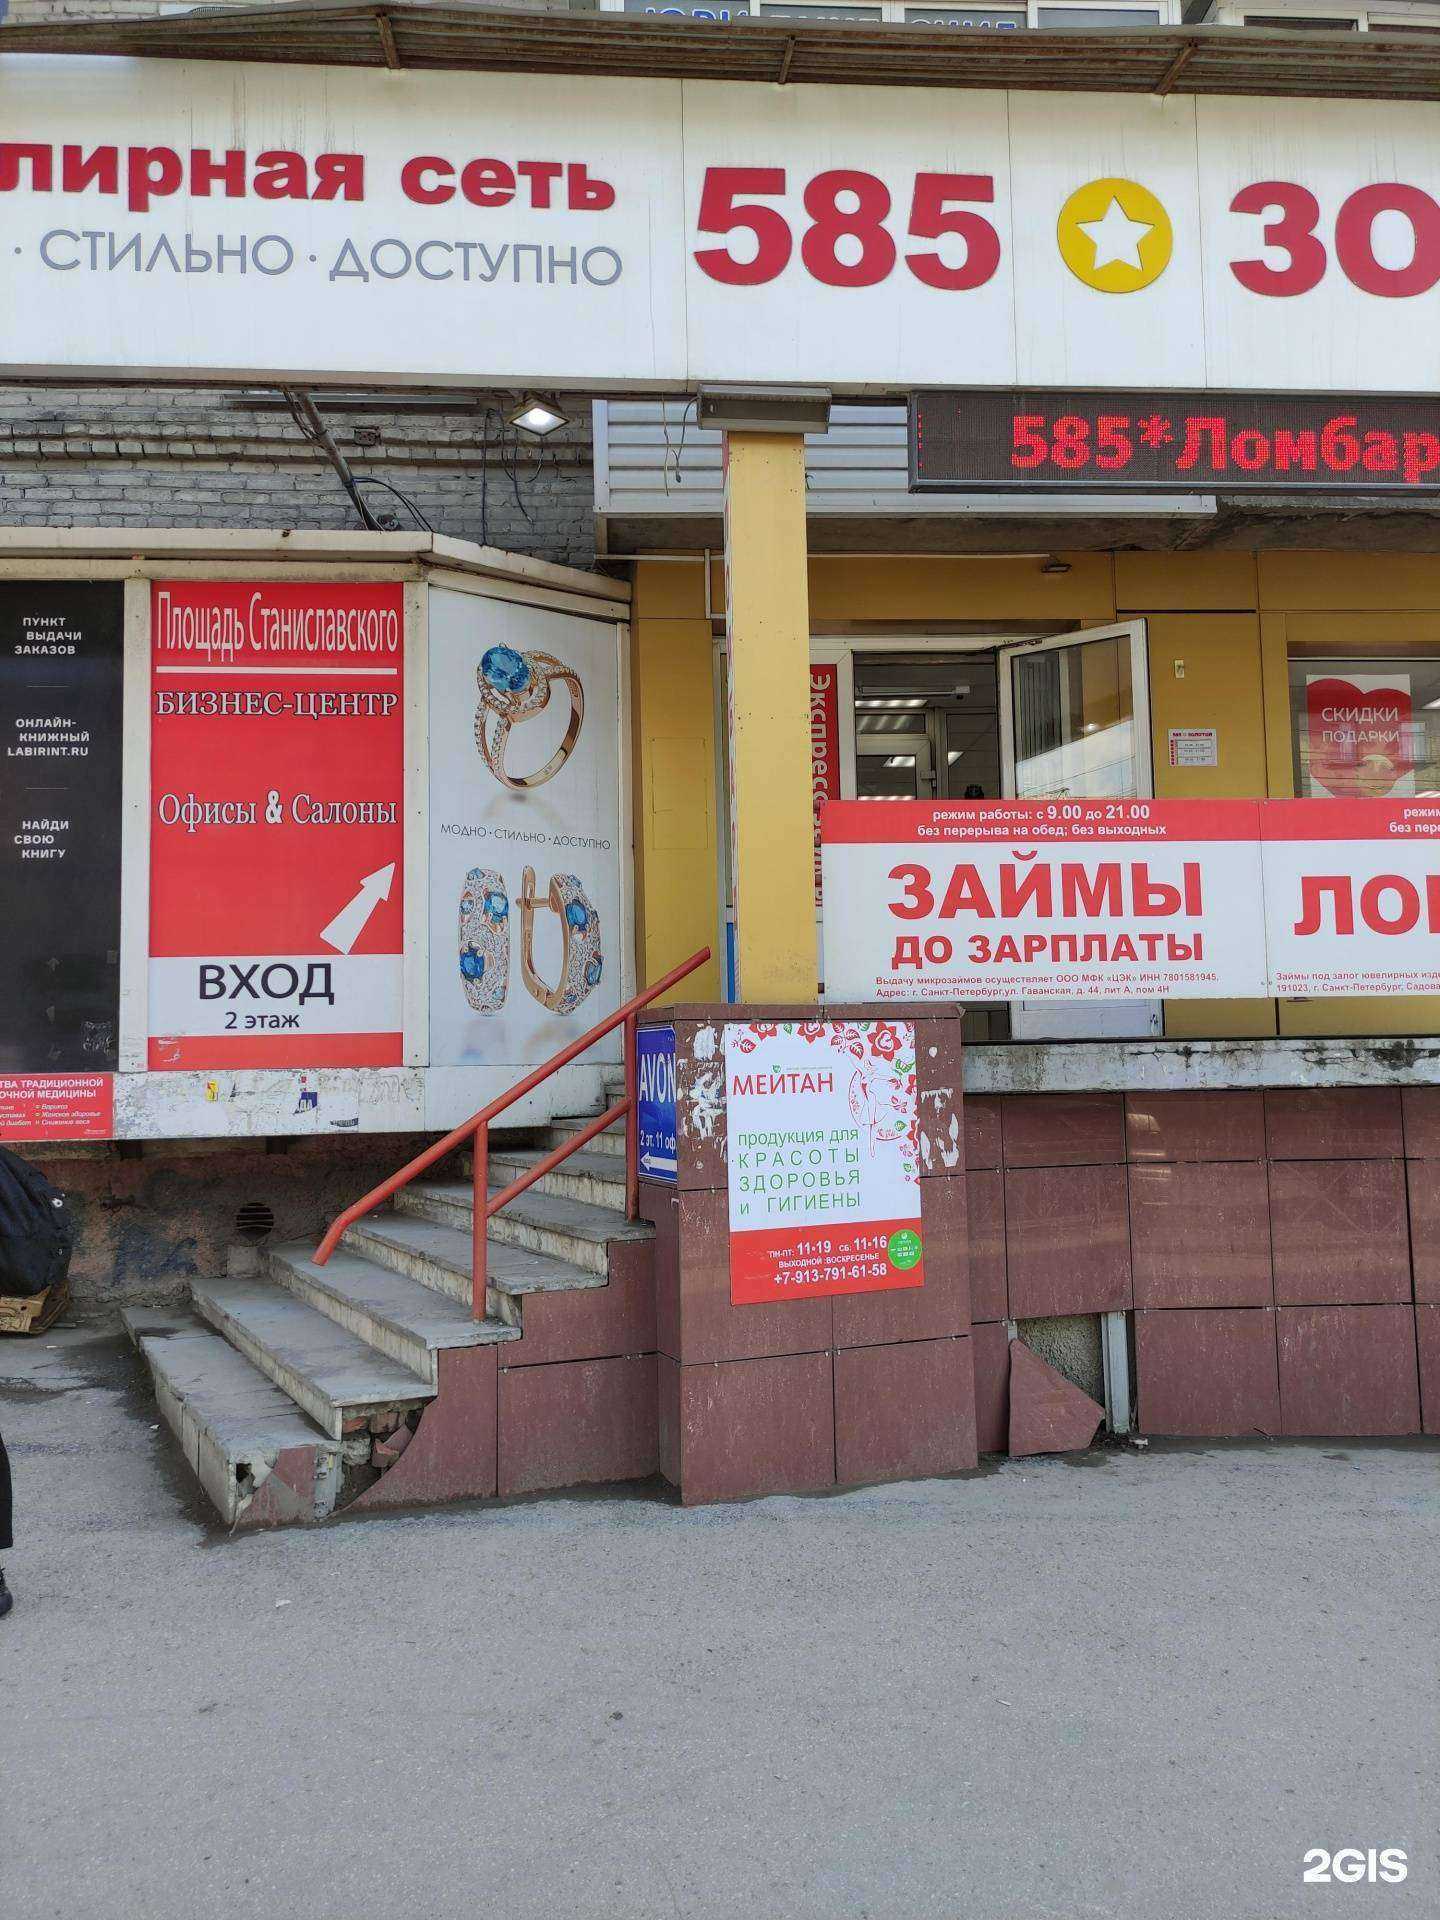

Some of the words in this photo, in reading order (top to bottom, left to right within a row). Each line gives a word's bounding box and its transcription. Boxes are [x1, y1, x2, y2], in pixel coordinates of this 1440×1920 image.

[0, 143, 365, 213] лирная
[400, 156, 617, 211] сеть
[693, 166, 1001, 291] 585
[40, 228, 294, 277] СТИЛЬНО
[328, 237, 623, 287] ДОСТУПНО
[22, 616, 67, 627] ПУНКТ
[157, 591, 245, 662] Площадь
[249, 591, 399, 652] Станиславского
[26, 631, 82, 642] ВЫДАЧИ
[14, 645, 76, 655] ЗАКАЗОВ
[156, 691, 399, 720] БИЗНЕС-ЦЕНТР
[15, 716, 77, 728] ОНЛАЙН-
[1321, 707, 1399, 724] СКИДКИ
[19, 731, 90, 742] КНИЖНЫЙ
[1322, 730, 1400, 744] ПОДАРКИ
[7, 746, 89, 756] LABIRINT.RU
[158, 793, 256, 833] Офисы
[265, 790, 283, 824] &
[291, 793, 398, 825] Салоны
[932, 810, 976, 822] режим
[979, 809, 1032, 821] работы:
[1036, 811, 1043, 820] с
[1046, 805, 1082, 820] 9.00
[1085, 810, 1102, 821] до
[1105, 805, 1150, 820] 21.00
[22, 818, 69, 831] НАЙДИ
[917, 825, 940, 836] без
[944, 827, 1009, 839] перерыва
[1013, 826, 1028, 835] на
[1032, 825, 1068, 837] обед;
[1071, 824, 1094, 835] без
[1097, 825, 1166, 837] выходных
[1389, 821, 1411, 833] без
[14, 835, 55, 845] СВОЮ
[440, 823, 487, 838] МОДНО
[494, 828, 546, 844] СТИЛЬНО
[552, 835, 611, 850] ДОСТУПНО
[22, 849, 66, 858] КНИГУ
[887, 850, 1203, 920] ЗАЙМЫ
[1294, 874, 1440, 936] ЛО
[891, 935, 953, 970] ДО
[967, 933, 1203, 963] ЗАРПЛАТЫ
[199, 963, 335, 1006] ВХОД
[876, 976, 914, 987] Выдачу
[985, 974, 1053, 986] осуществляет
[1056, 974, 1079, 983] ООО
[1082, 974, 1104, 983] МФК
[1139, 973, 1161, 982] ИНН
[1276, 971, 1309, 981] Займы
[1312, 971, 1330, 981] под
[1332, 971, 1358, 981] залог
[1361, 971, 1418, 982] ювелирных
[876, 988, 910, 998] Адрес:
[1136, 986, 1156, 994] пом
[224, 1012, 238, 1029] 2
[244, 1013, 300, 1029] этаж
[22, 1078, 104, 1089] ТРАДИЦИОННОЙ
[639, 1052, 677, 1103] AVON
[37, 1089, 96, 1099] МЕДИЦИНЫ
[640, 1129, 645, 1146] 2
[655, 1131, 663, 1149] 11
[738, 1130, 824, 1149] продукция
[829, 1129, 859, 1144] для
[739, 1148, 859, 1168] КРАСОТЫ
[739, 1169, 860, 1194] ЗДОРОВЬЯ
[740, 1203, 750, 1215] и
[767, 1191, 860, 1213] ГИГИЕНЫ
[778, 1257, 822, 1269] ВЫХОДНОЙ
[826, 1252, 880, 1265] ВОСКРЕСЕНЬЕ
[773, 1262, 888, 1285] +7-913-791-61-58
